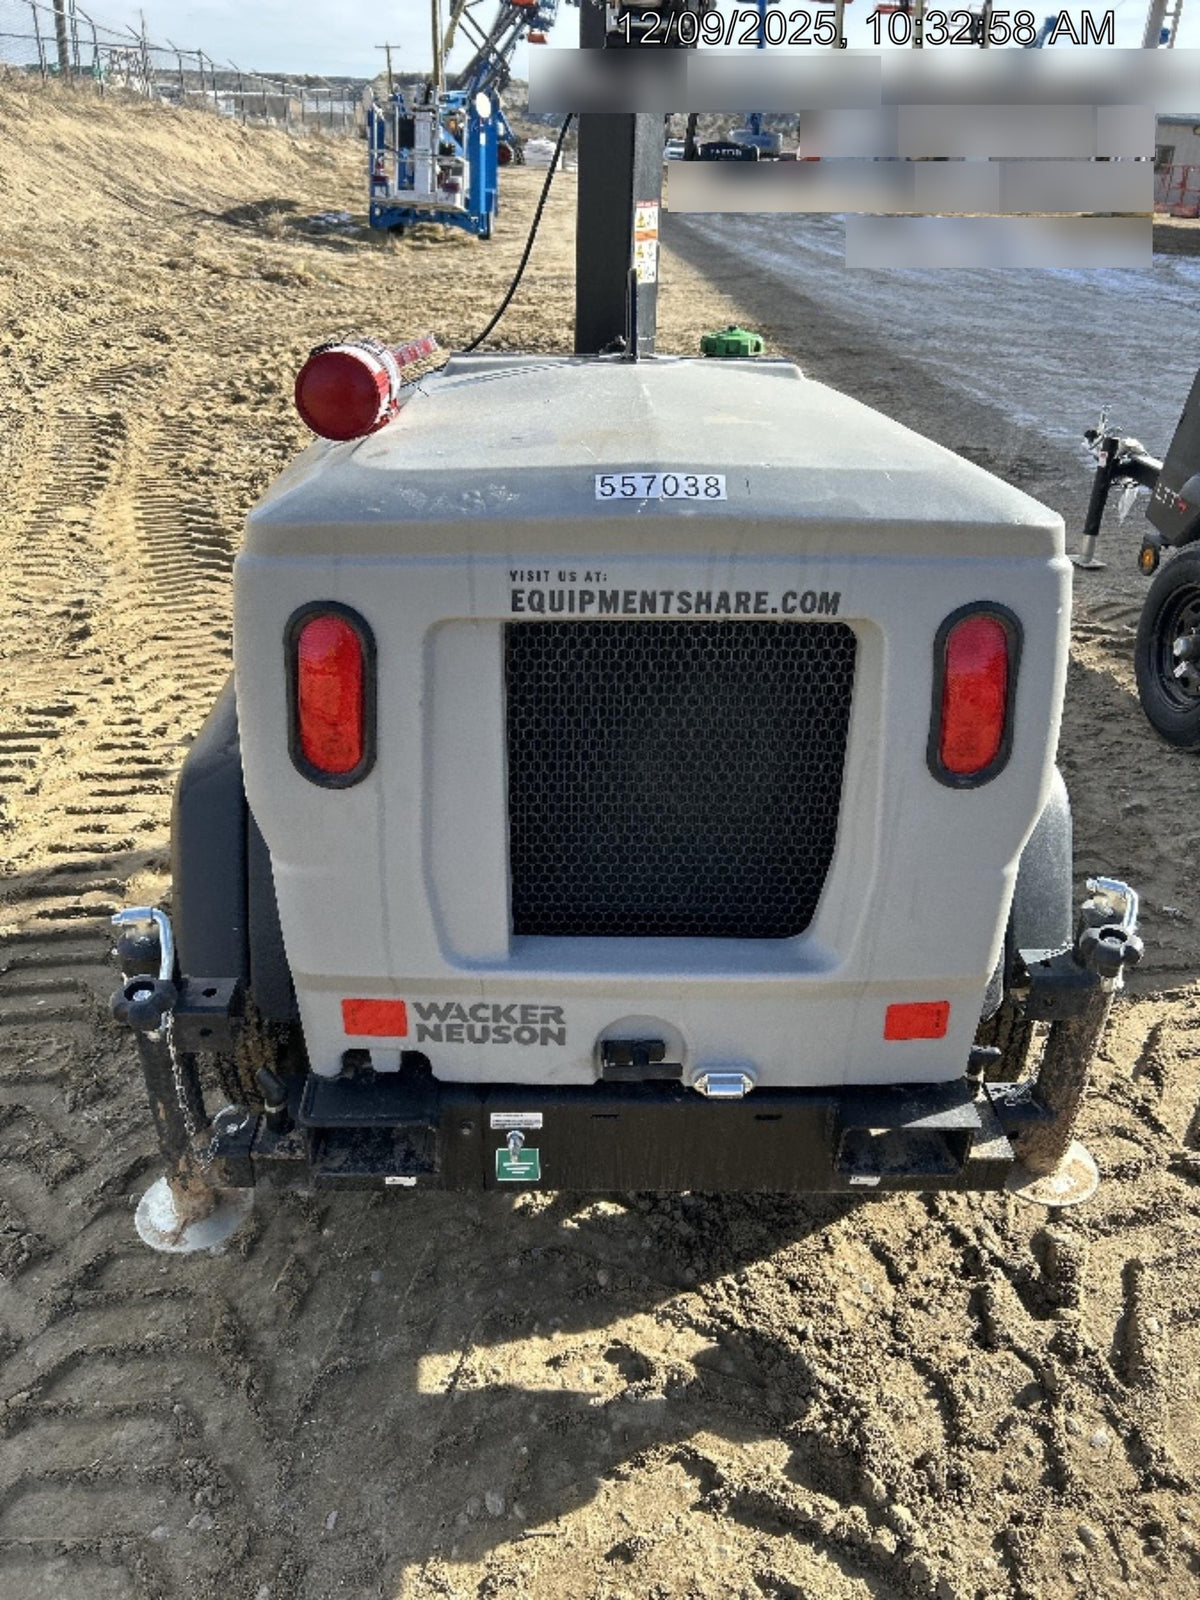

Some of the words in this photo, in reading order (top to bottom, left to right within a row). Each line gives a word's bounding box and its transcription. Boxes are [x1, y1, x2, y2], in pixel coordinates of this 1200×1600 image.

[599, 474, 721, 498] 557038
[509, 570, 550, 582] VISIT
[558, 571, 577, 582] US
[584, 571, 608, 583] AT:
[511, 588, 842, 616] EQUIPMENTSHARE.COM
[412, 1002, 566, 1025] WACKER
[416, 1024, 566, 1046] NEUSON
